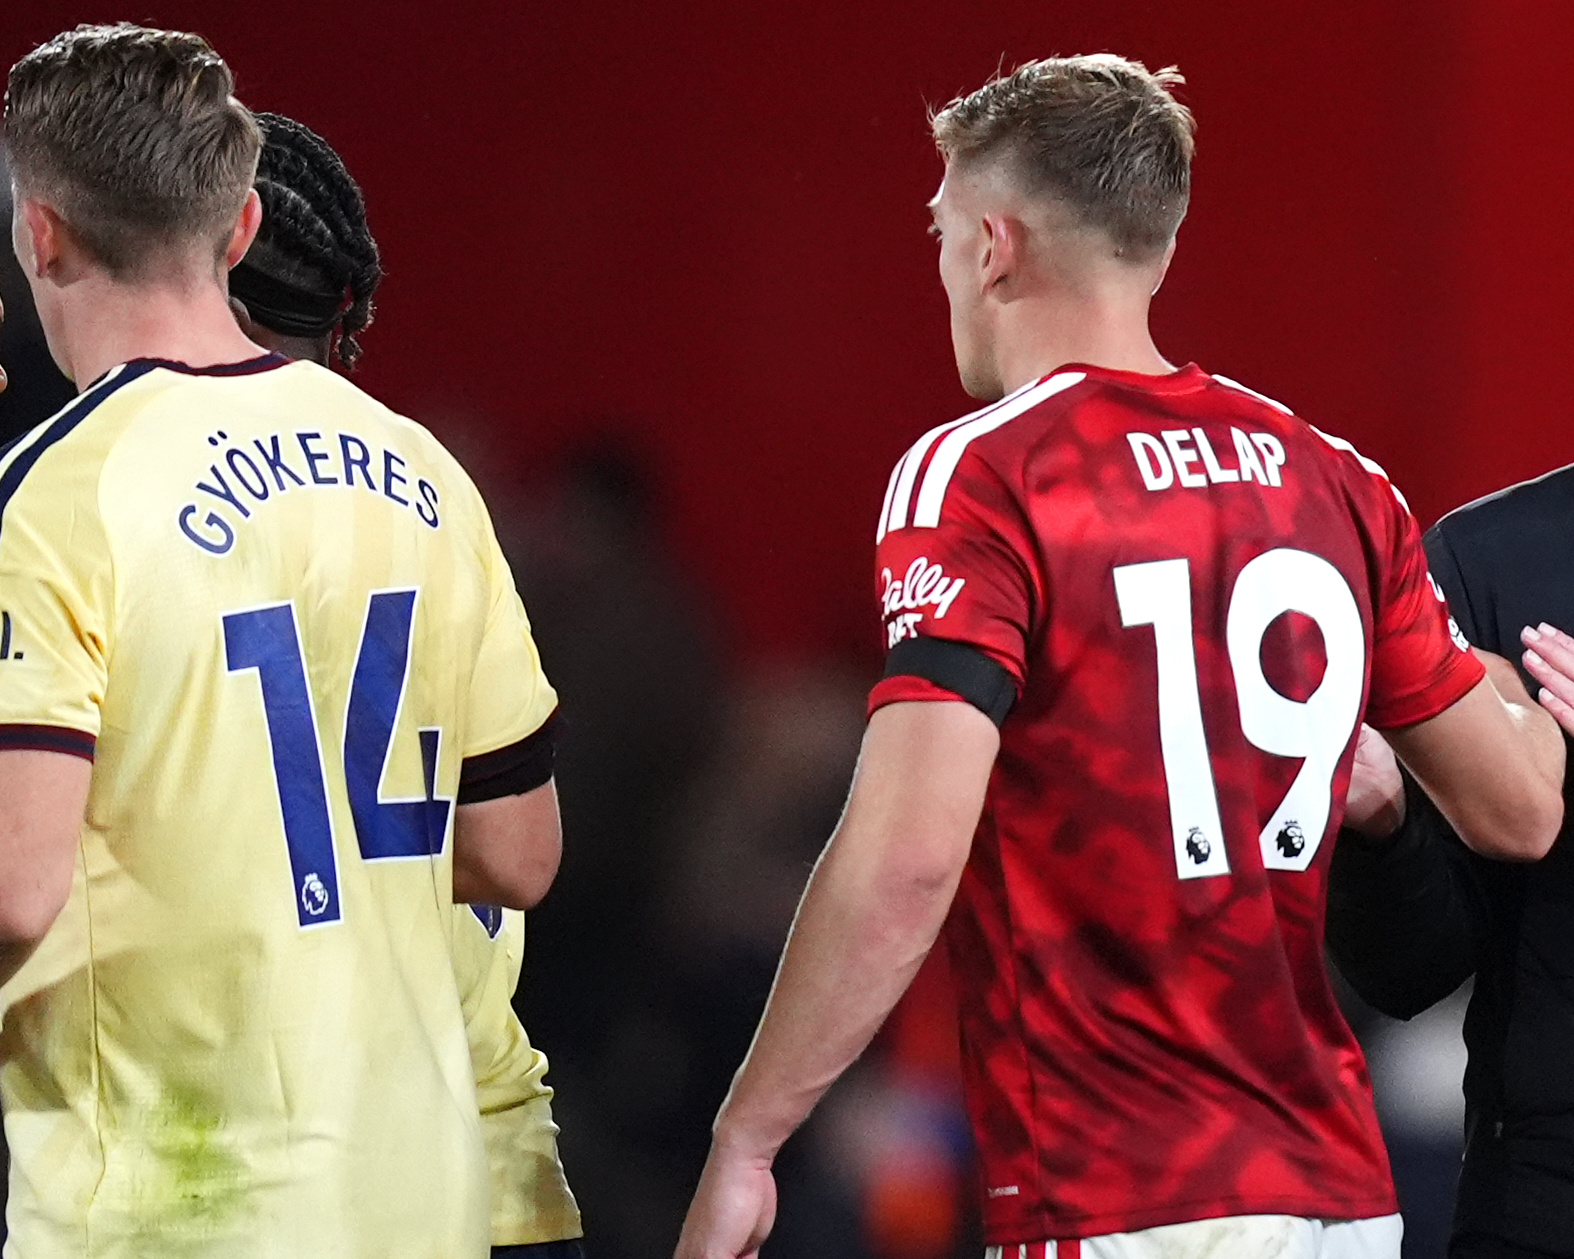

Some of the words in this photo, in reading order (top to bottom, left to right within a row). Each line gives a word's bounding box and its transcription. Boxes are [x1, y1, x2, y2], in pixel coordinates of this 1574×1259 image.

[179, 430, 440, 555] GYÖKERES
[1126, 426, 1286, 491] DELAP
[221, 585, 456, 928] 14
[1112, 547, 1366, 881] 19
